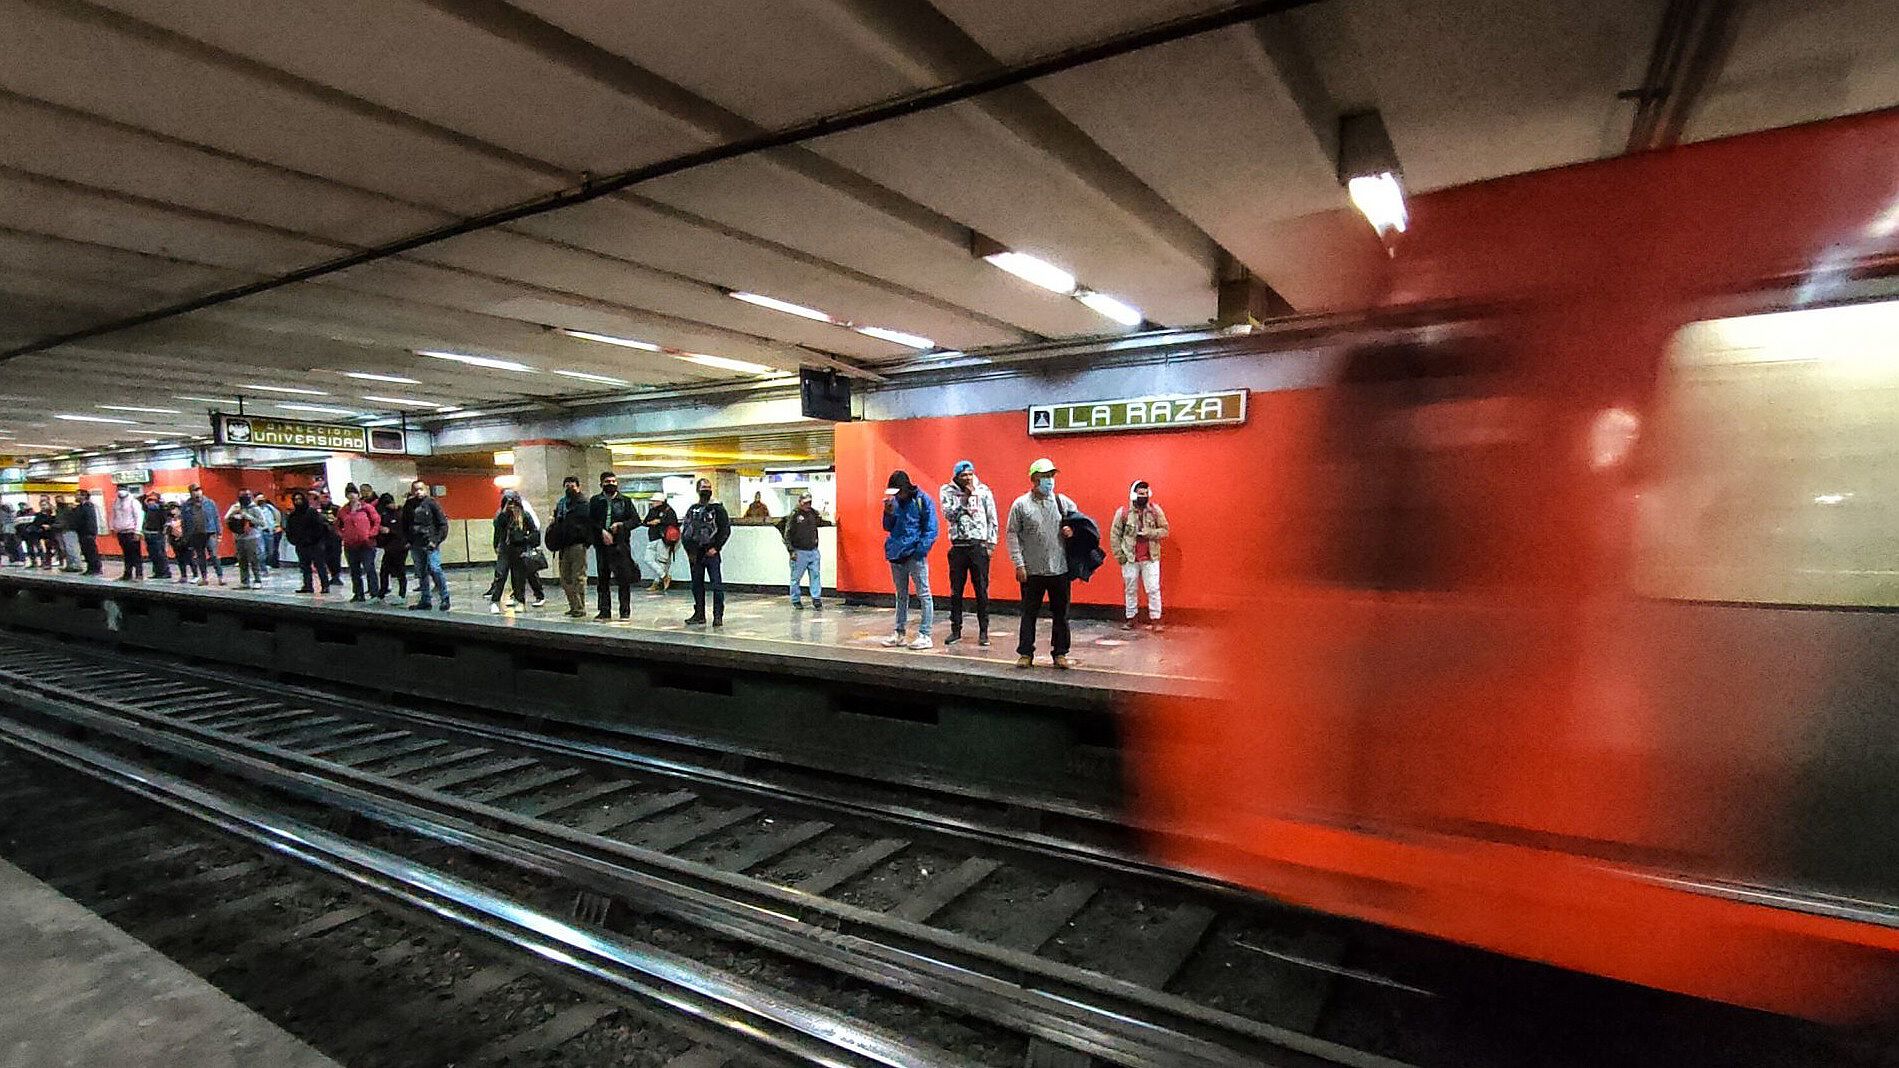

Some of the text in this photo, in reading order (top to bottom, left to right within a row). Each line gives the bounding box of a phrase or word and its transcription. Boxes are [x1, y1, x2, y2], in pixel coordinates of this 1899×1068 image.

[1068, 398, 1222, 428] LA RAZA
[254, 430, 363, 448] UNIVERSIDAD
